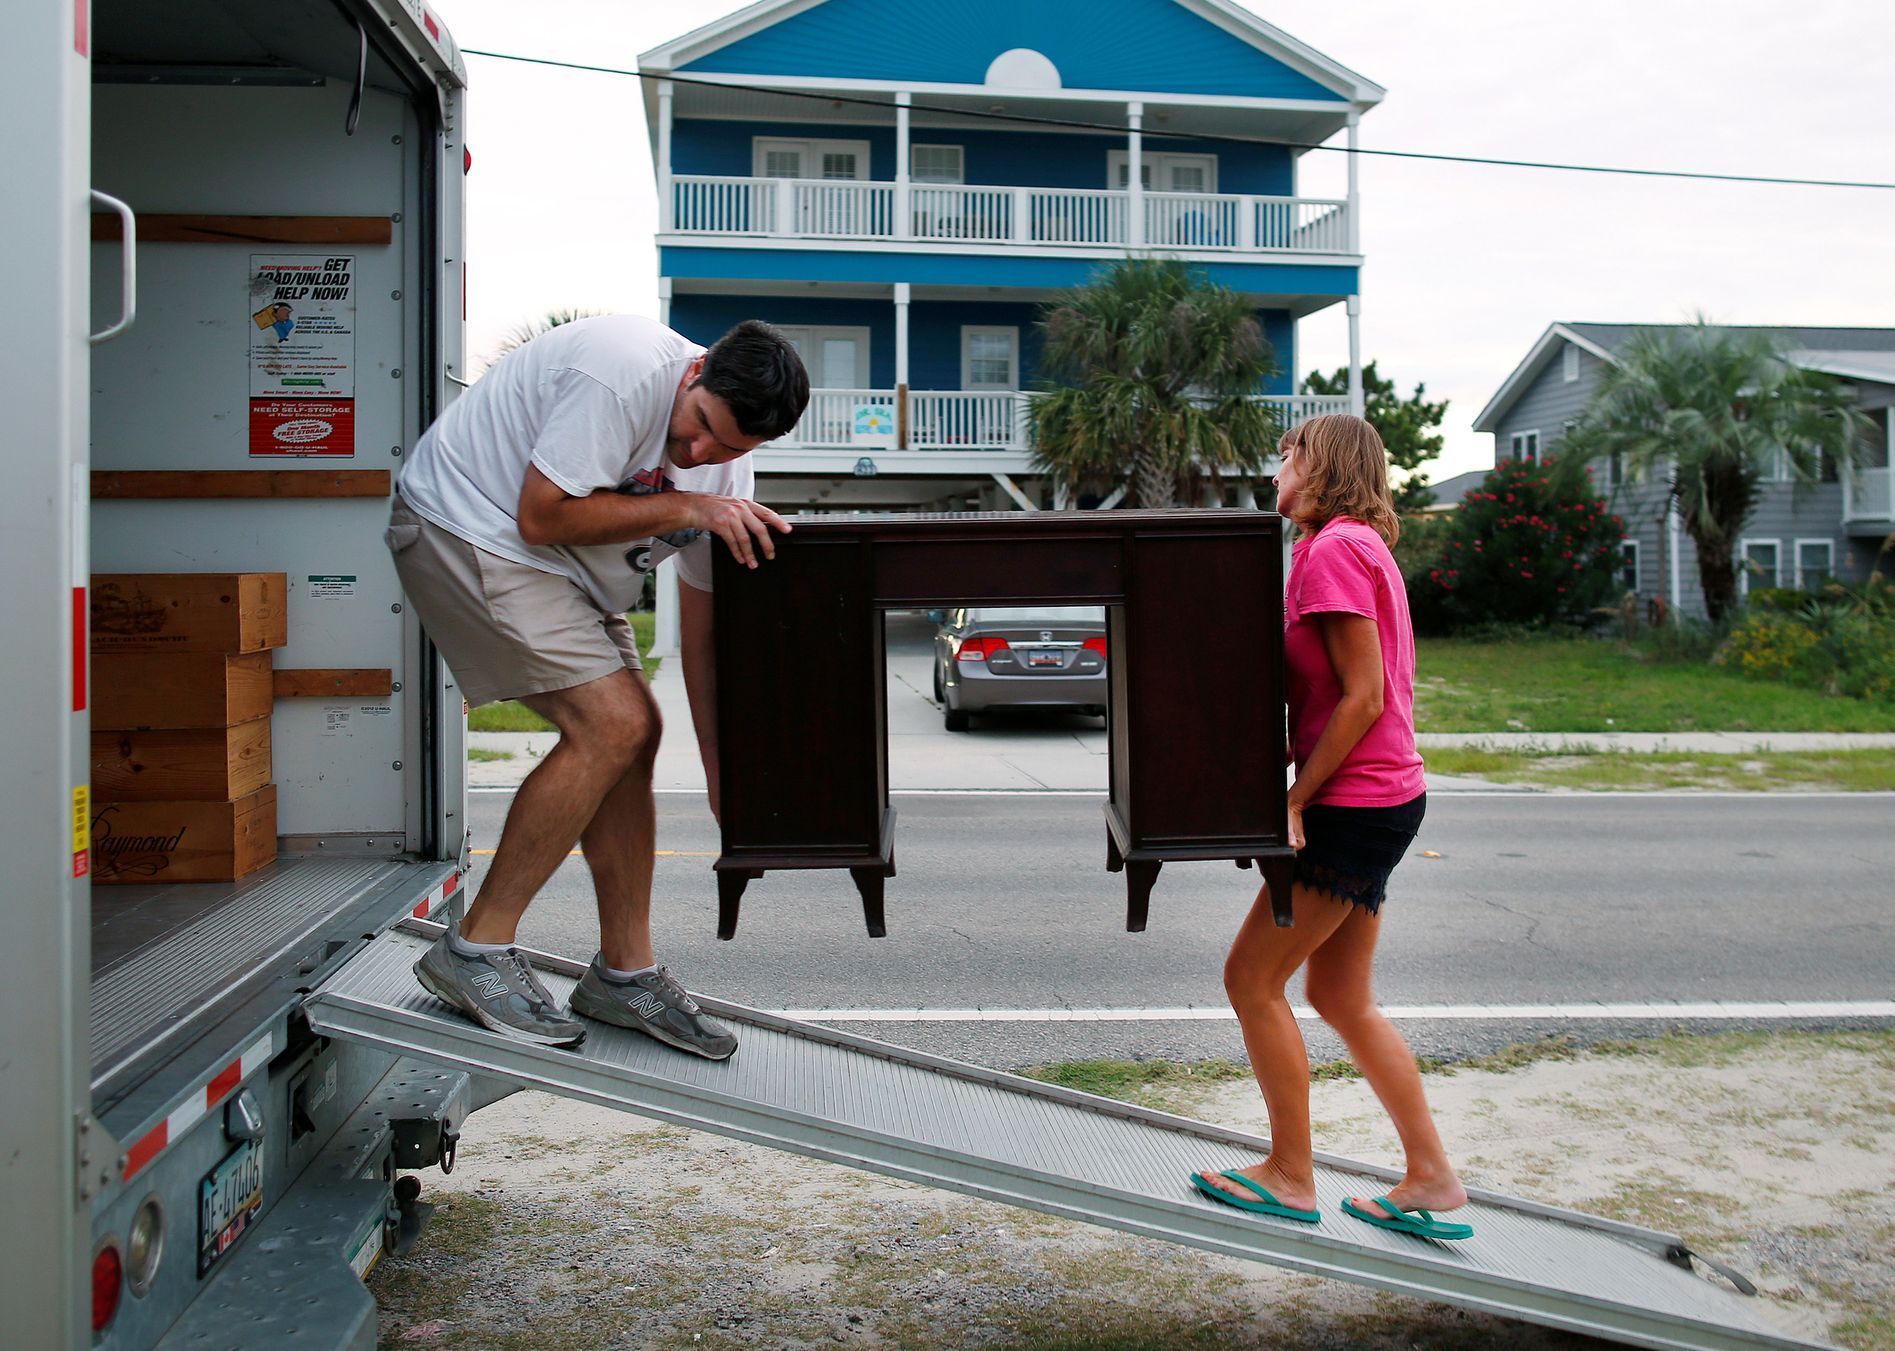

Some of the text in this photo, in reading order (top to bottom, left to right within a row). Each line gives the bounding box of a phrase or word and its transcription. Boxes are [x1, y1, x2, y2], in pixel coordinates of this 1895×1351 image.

[324, 258, 351, 271] GET
[273, 286, 349, 300] HELP NOW!
[91, 806, 187, 866] Raymond
[472, 972, 508, 1000] N
[628, 991, 665, 1018] N
